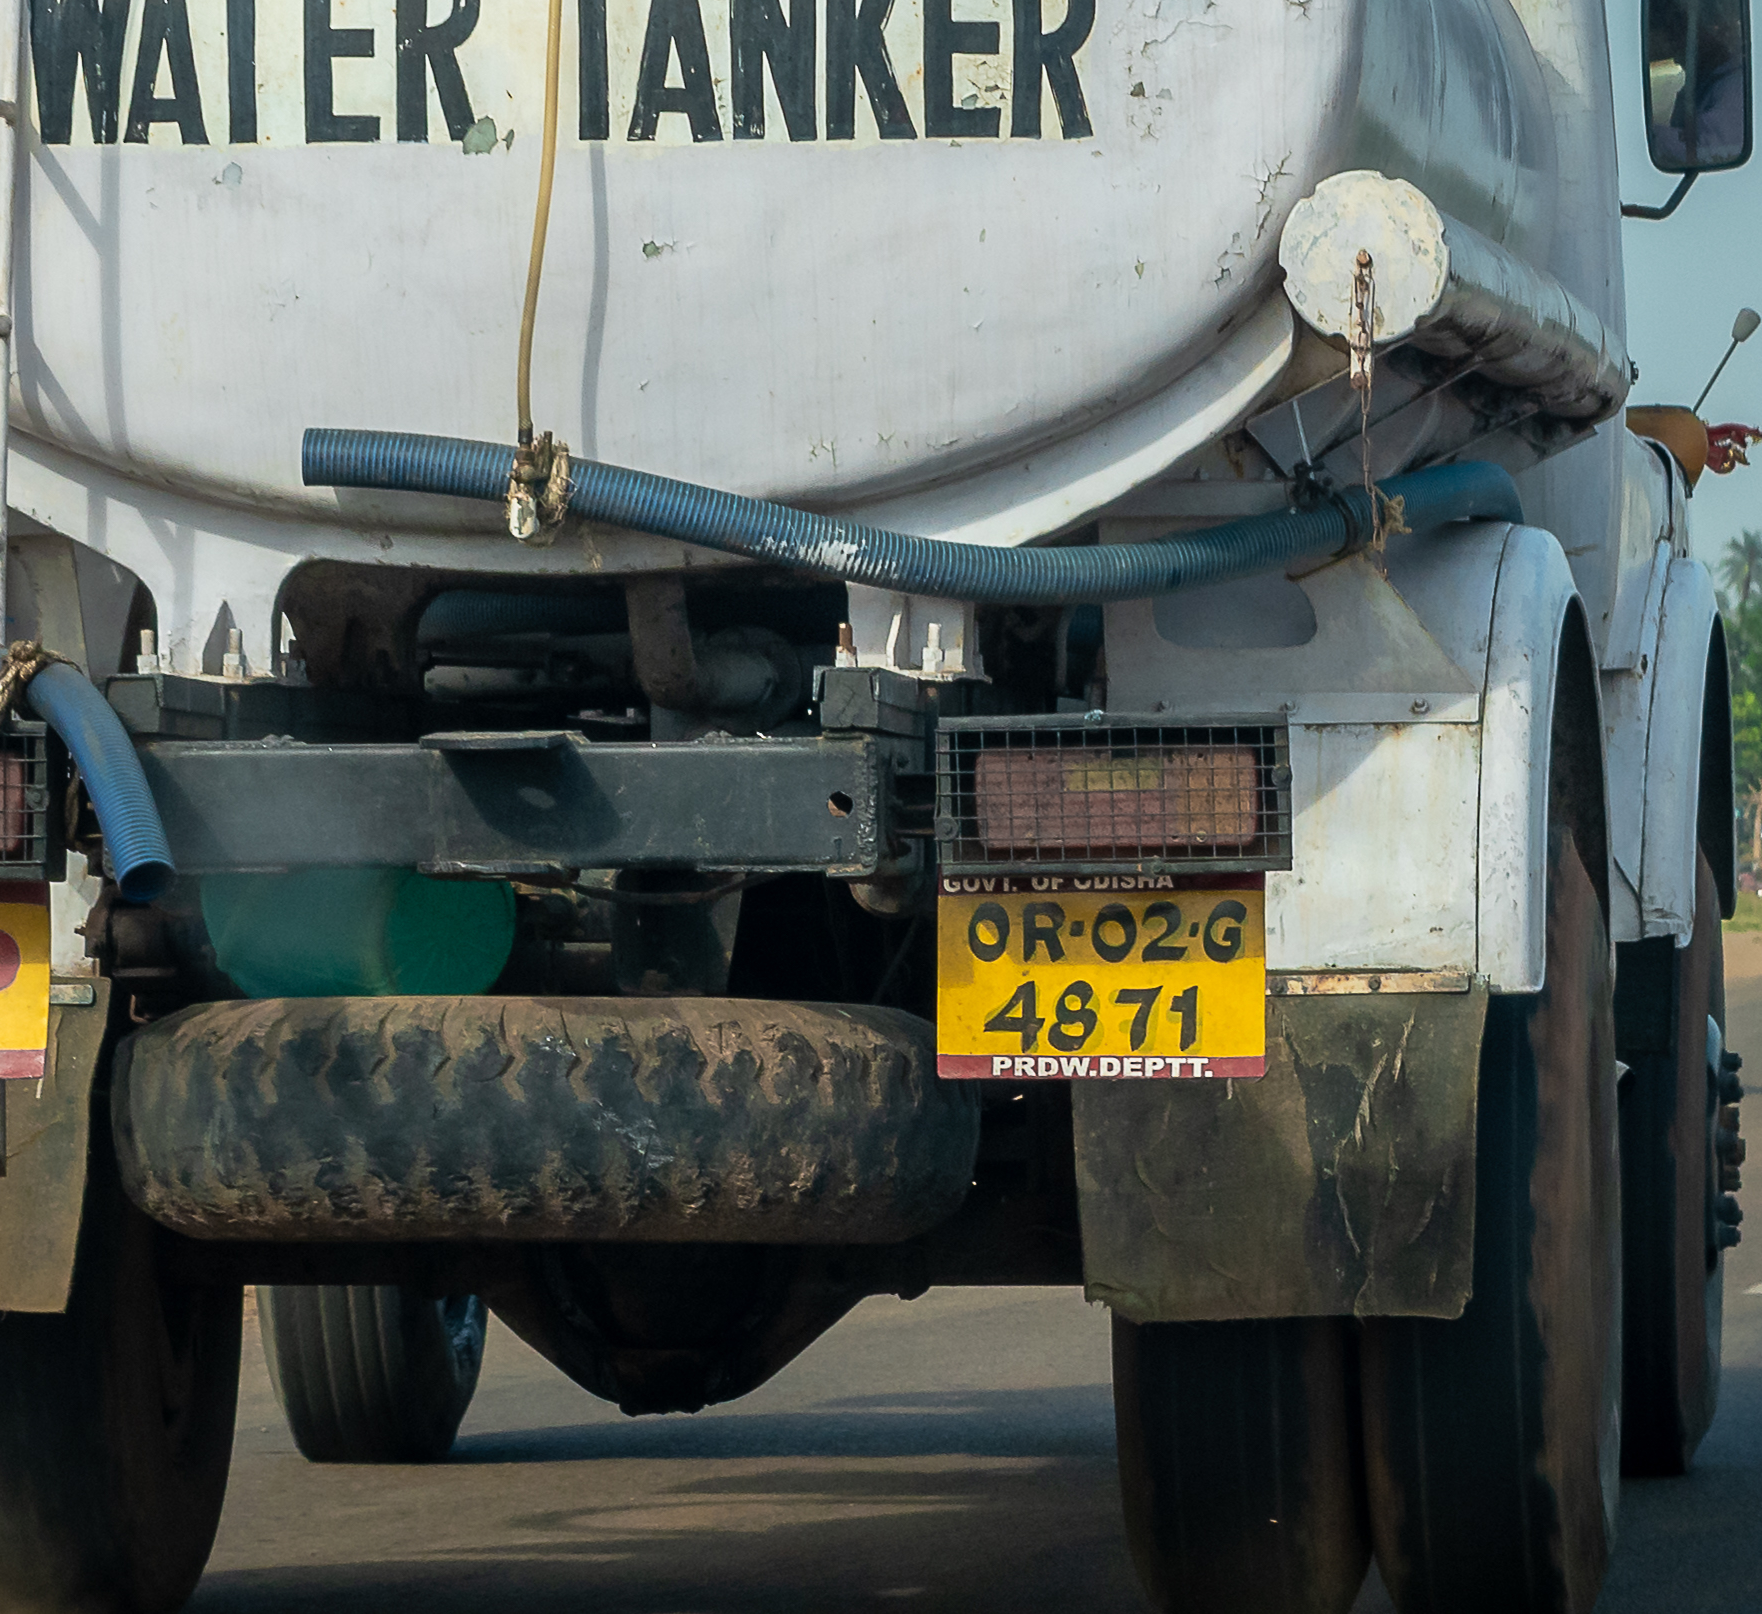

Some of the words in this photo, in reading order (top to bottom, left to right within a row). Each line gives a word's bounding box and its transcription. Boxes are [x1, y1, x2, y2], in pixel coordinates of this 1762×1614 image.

[943, 875, 1019, 893] GOVT.
[1031, 875, 1064, 891] OF
[1073, 874, 1175, 891] ODISHA
[983, 980, 1200, 1054] 4871
